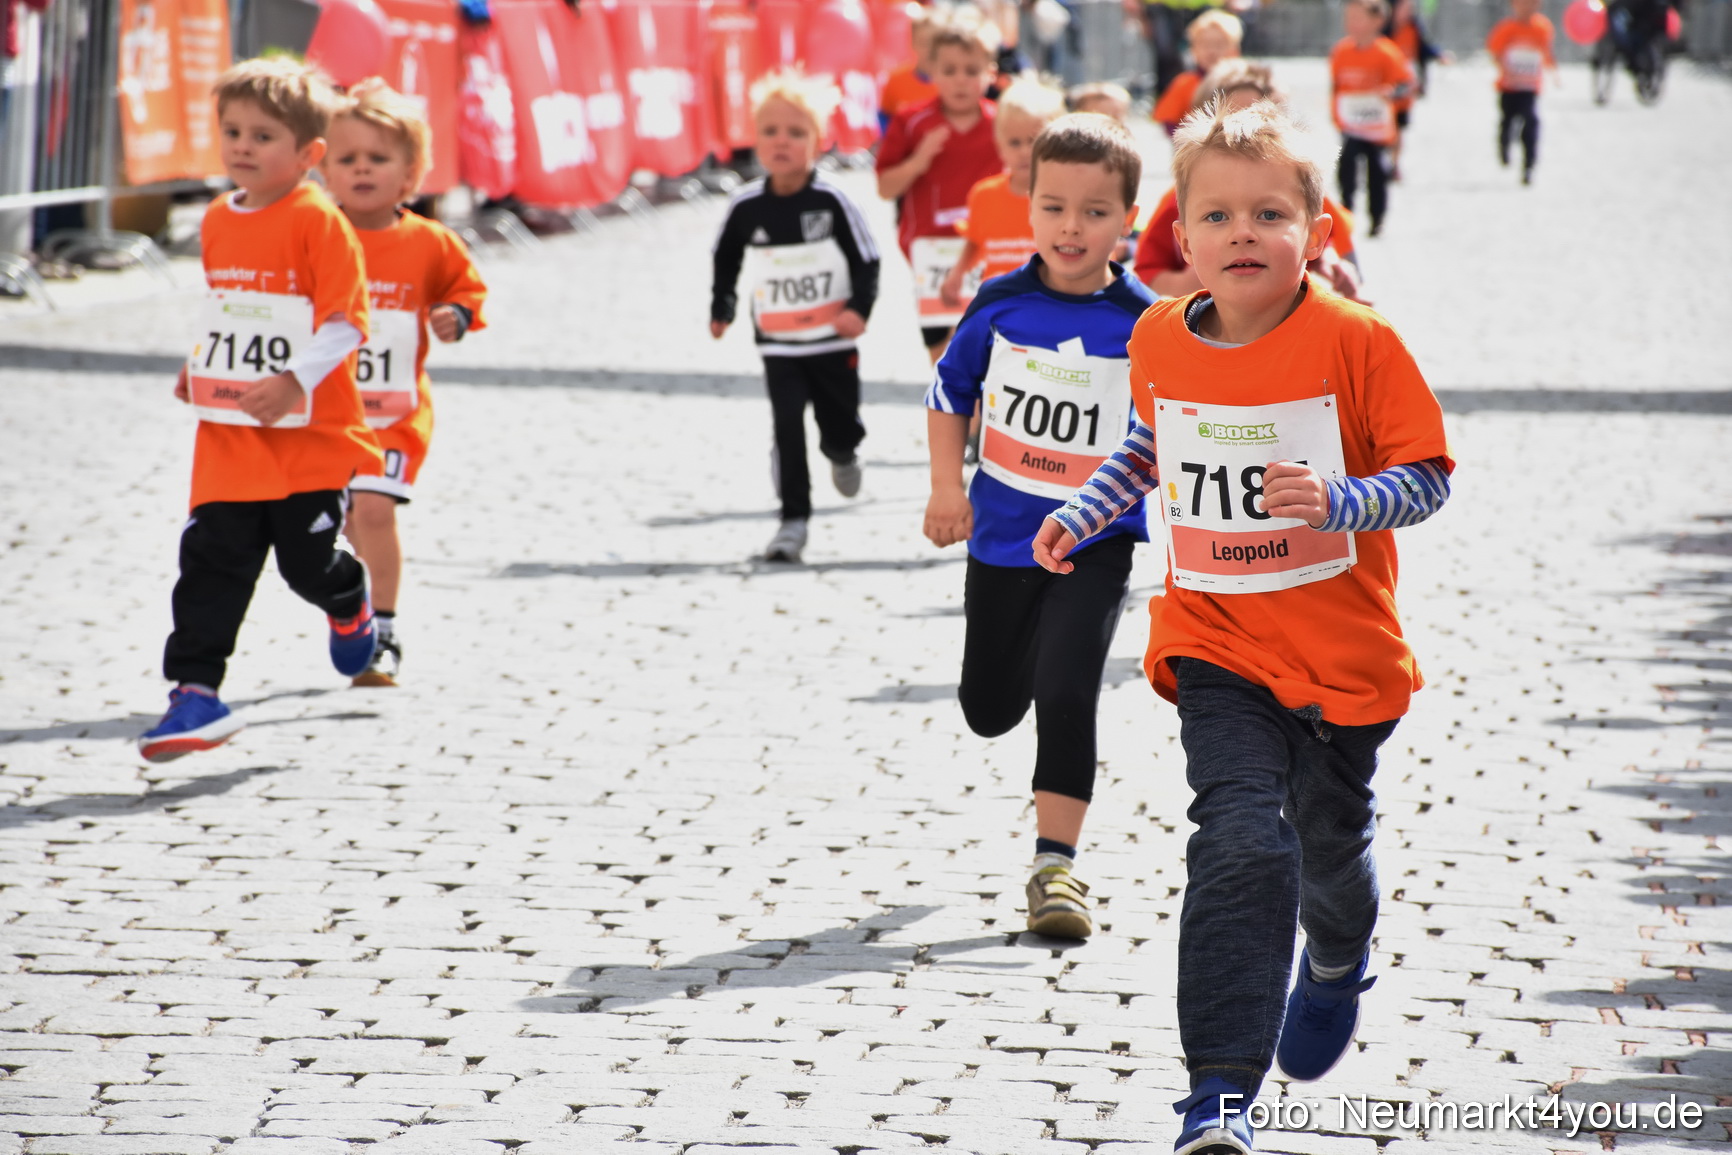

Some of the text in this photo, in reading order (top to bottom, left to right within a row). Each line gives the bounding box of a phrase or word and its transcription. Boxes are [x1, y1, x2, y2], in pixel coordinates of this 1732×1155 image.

[766, 271, 833, 305] 7087
[205, 331, 291, 374] 7149
[1040, 362, 1091, 384] BOCK
[1003, 384, 1099, 446] 7001
[1213, 423, 1278, 440] BOCK
[1255, 438, 1280, 446] concepts
[1020, 451, 1067, 475] Anton
[1181, 460, 1308, 520] 718
[1170, 506, 1182, 518] B2
[1212, 538, 1289, 565] Leopold
